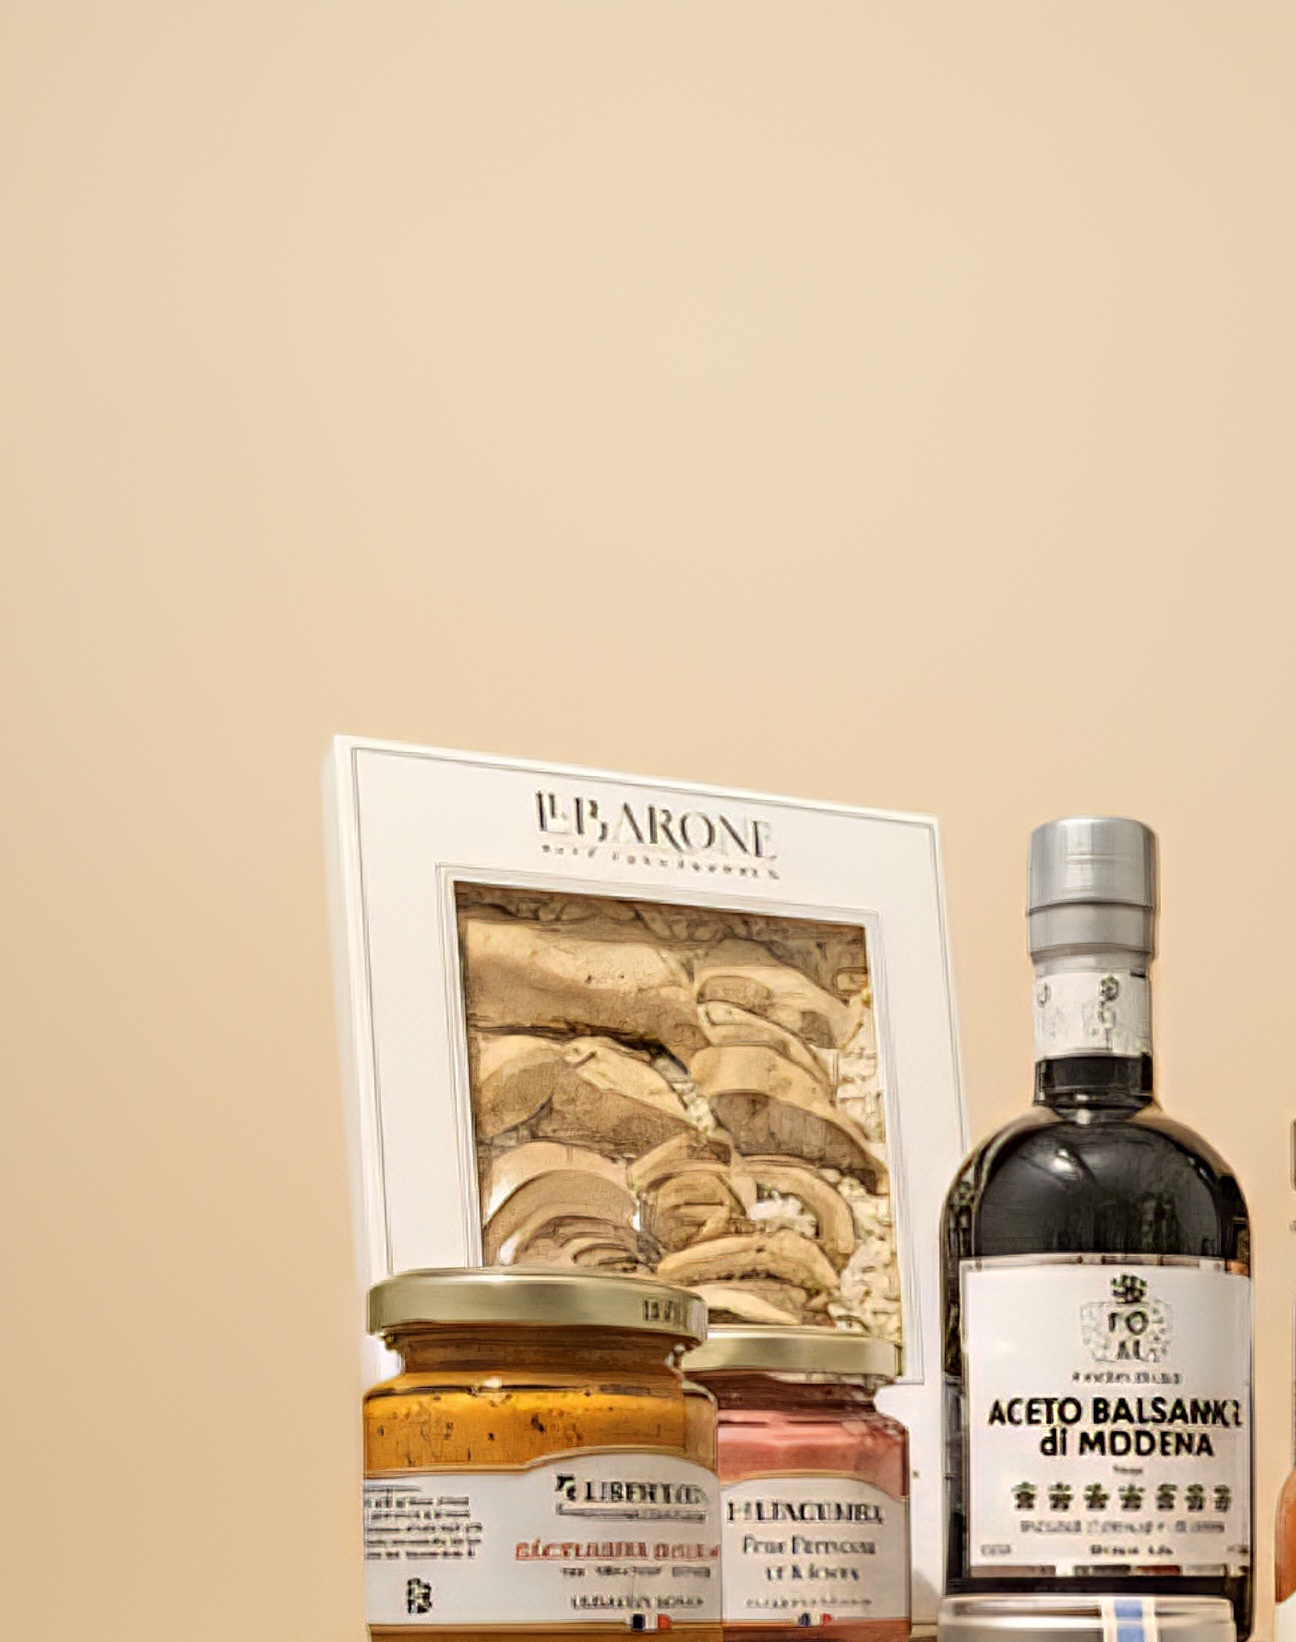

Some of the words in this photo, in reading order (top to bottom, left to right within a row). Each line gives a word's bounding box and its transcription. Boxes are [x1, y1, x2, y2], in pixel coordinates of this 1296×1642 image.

[988, 1398, 1082, 1426] ACETO
[1040, 1429, 1067, 1456] di
[1079, 1430, 1214, 1457] MODENA
